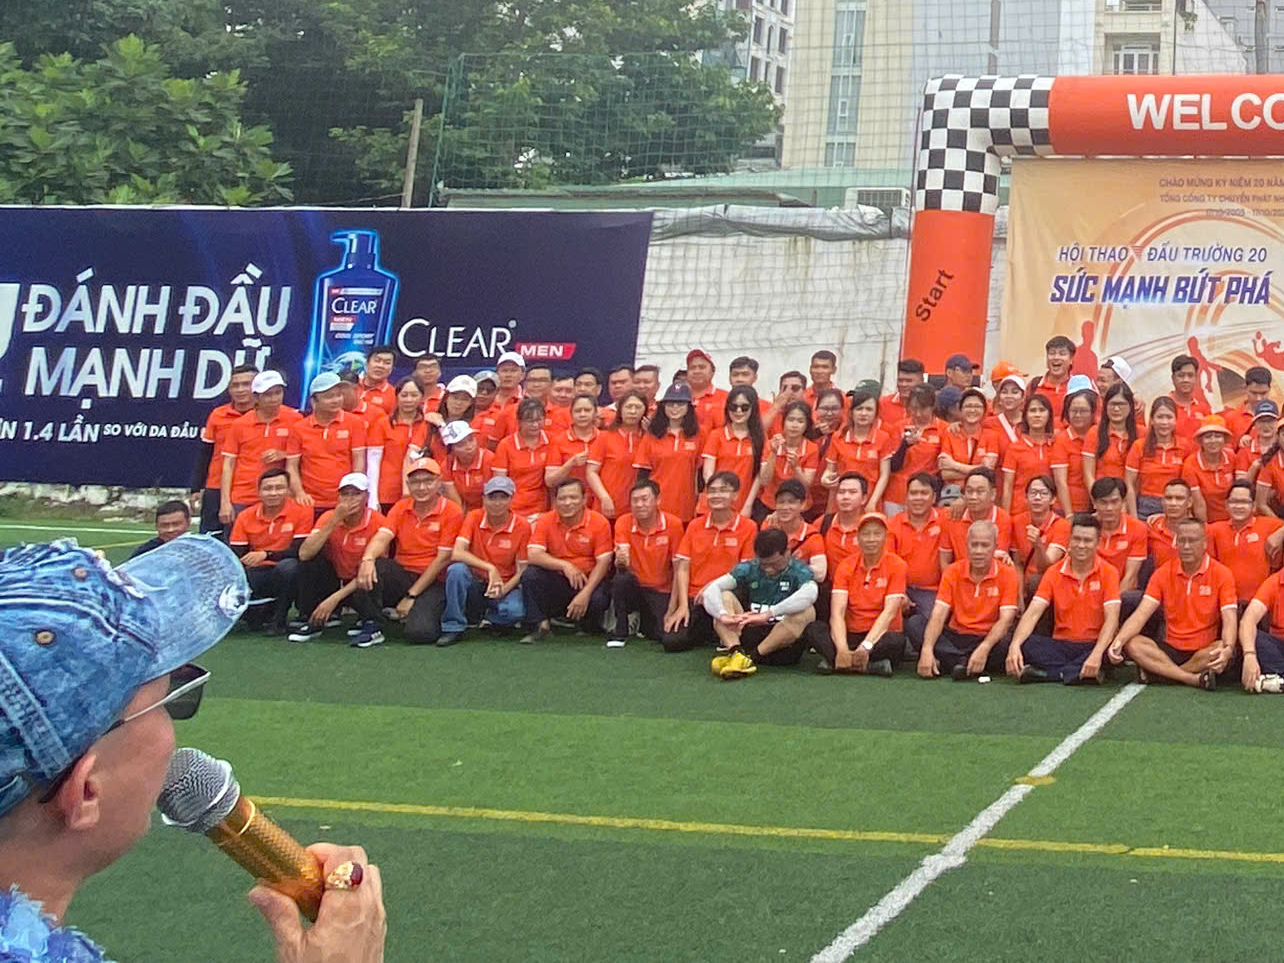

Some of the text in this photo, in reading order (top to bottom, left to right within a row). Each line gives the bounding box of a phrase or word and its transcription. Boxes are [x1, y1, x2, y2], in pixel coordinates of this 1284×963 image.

[1207, 194, 1218, 203] TY
[1253, 177, 1265, 188] 20
[1059, 241, 1268, 266] HỘI THAO ĐẤU TRƯỜNG 20
[21, 267, 171, 334] ĐÁNH
[178, 263, 292, 336] ĐẦU
[331, 296, 377, 314] CLEAR
[915, 269, 955, 322] Start
[1050, 267, 1274, 310] SỨC MẠNH BỨT PHÁ
[397, 317, 564, 359] CLEAR MEN
[24, 346, 186, 410] MẠNH
[23, 421, 54, 441] 1.4
[58, 413, 101, 443] LẦN
[103, 423, 121, 436] SO
[124, 421, 148, 437] VỚI
[149, 424, 168, 438] DA
[170, 421, 199, 438] ĐẦU
